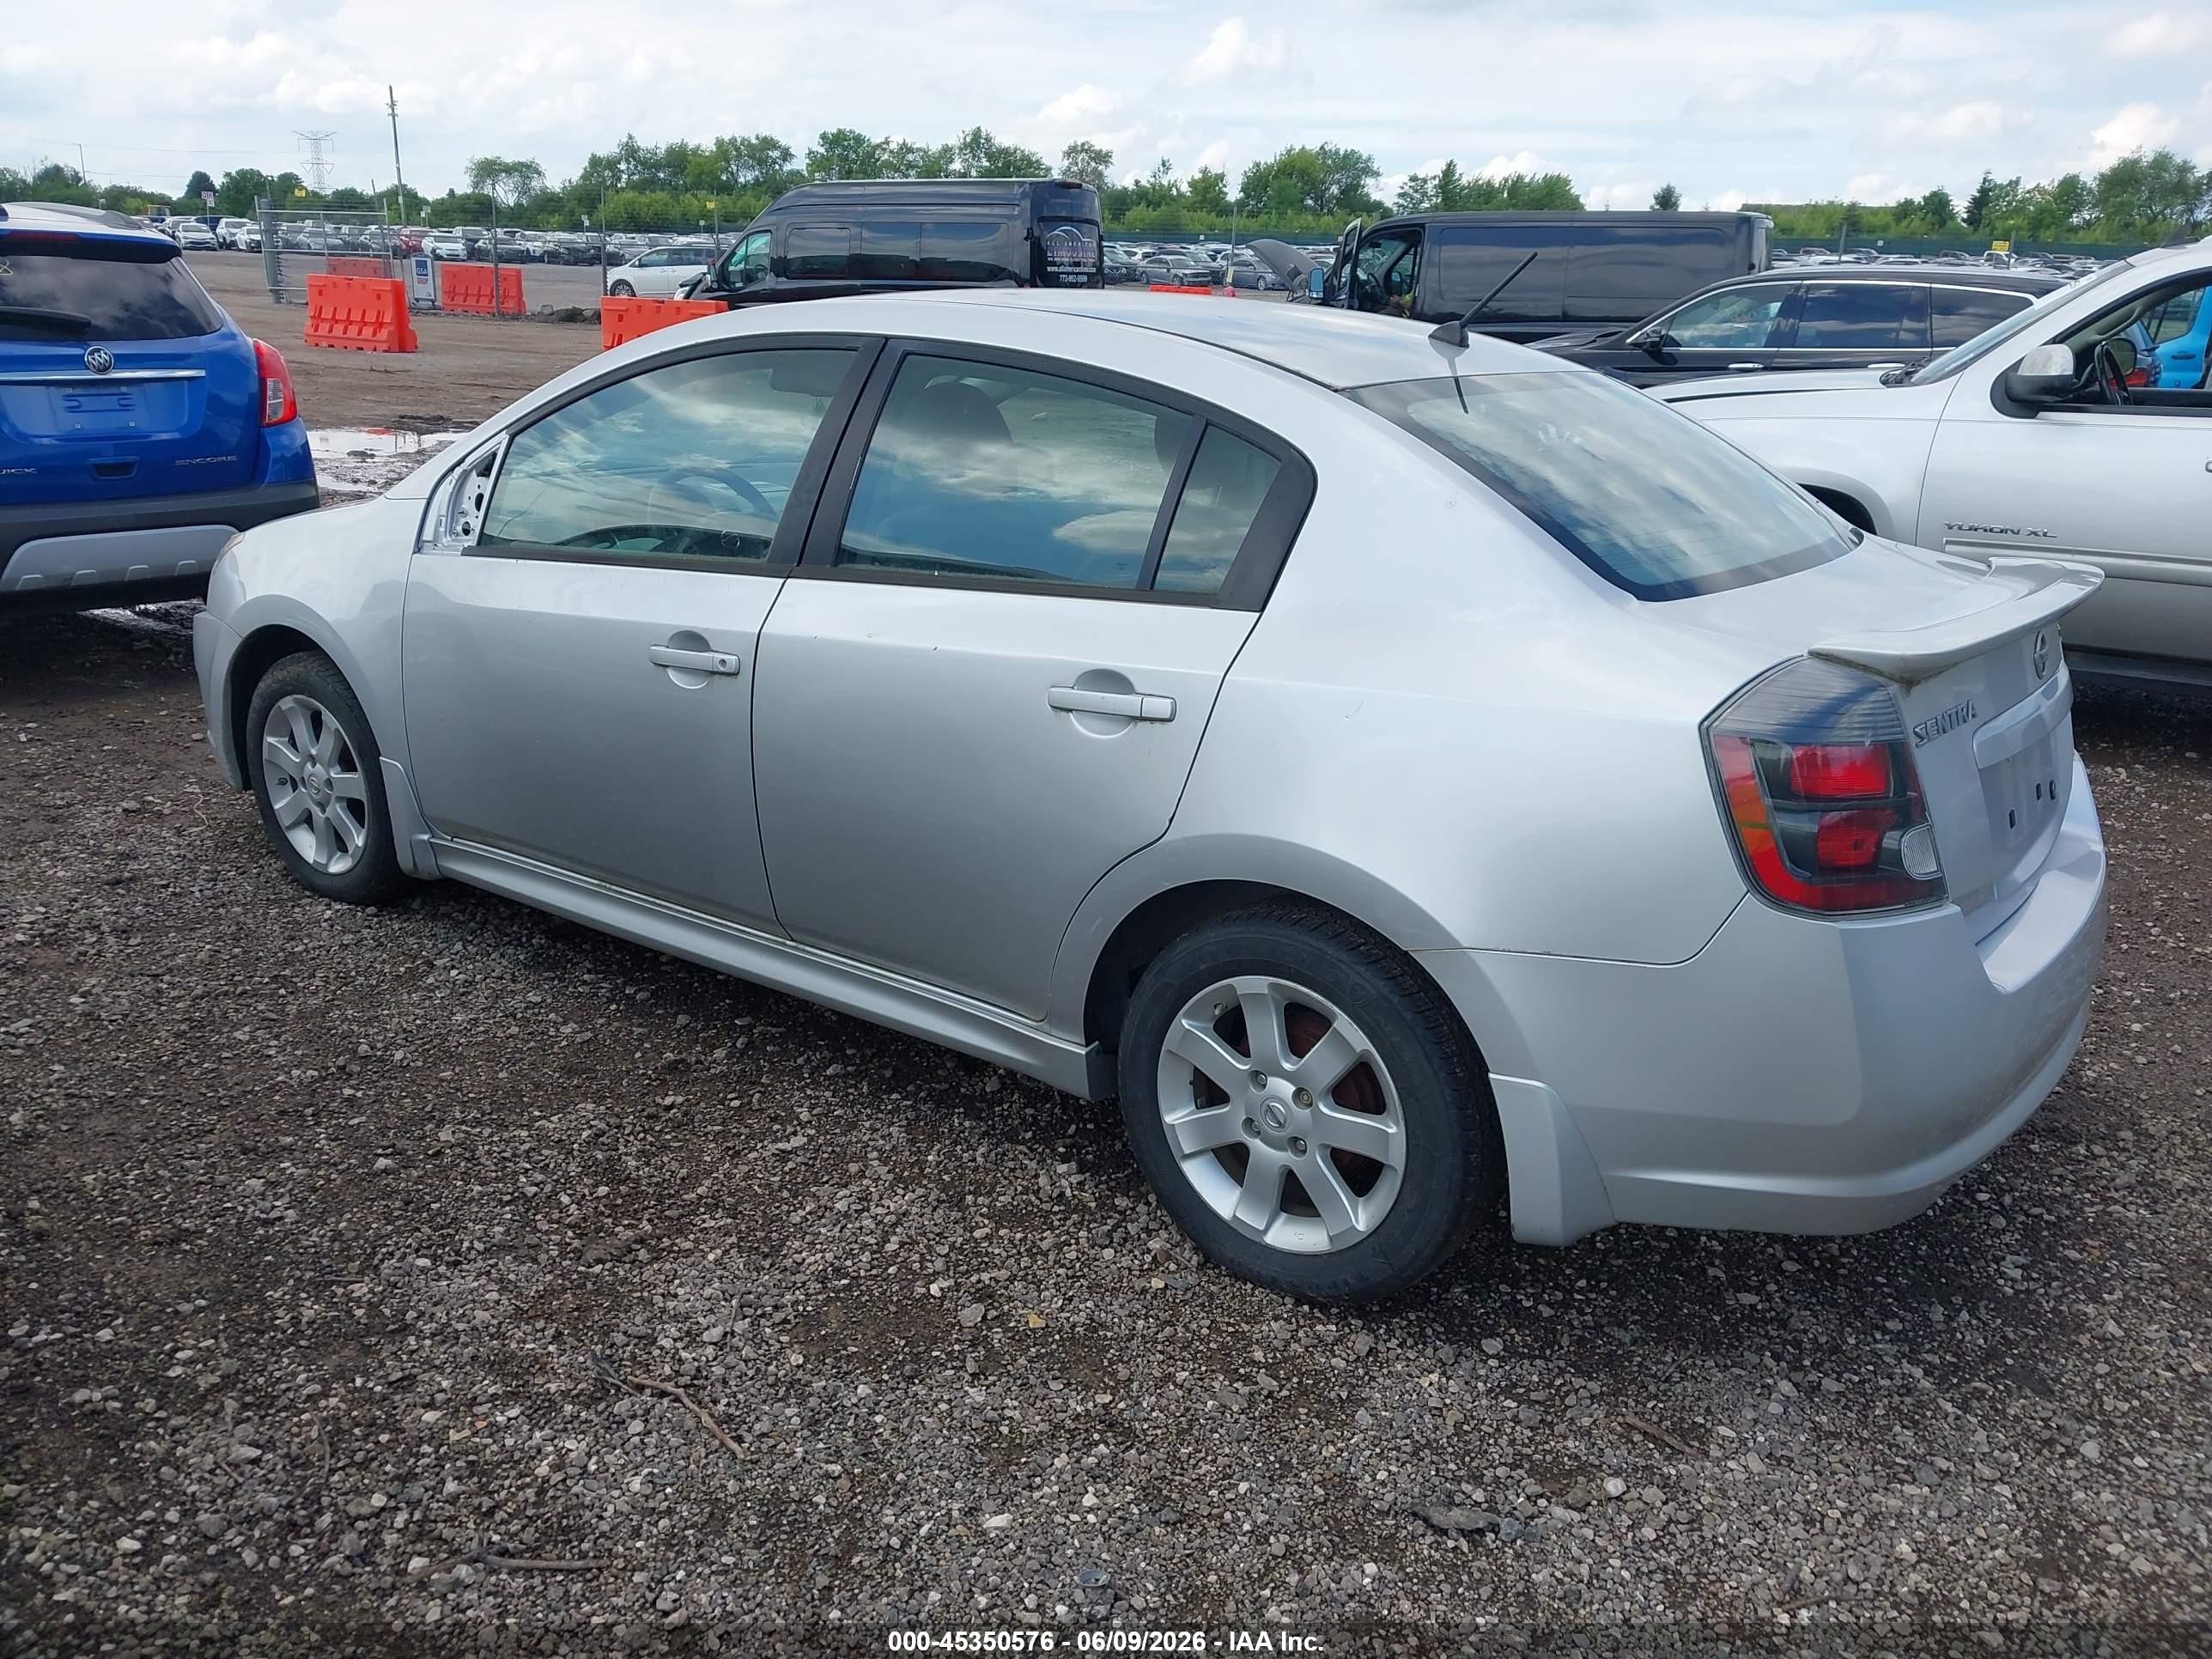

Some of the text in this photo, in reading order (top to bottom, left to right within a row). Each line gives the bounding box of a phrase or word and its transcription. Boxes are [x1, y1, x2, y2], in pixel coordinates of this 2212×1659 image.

[174, 456, 238, 465] ENCORE
[1943, 521, 2058, 538] YUKON XL
[1913, 699, 1978, 748] SENTRA
